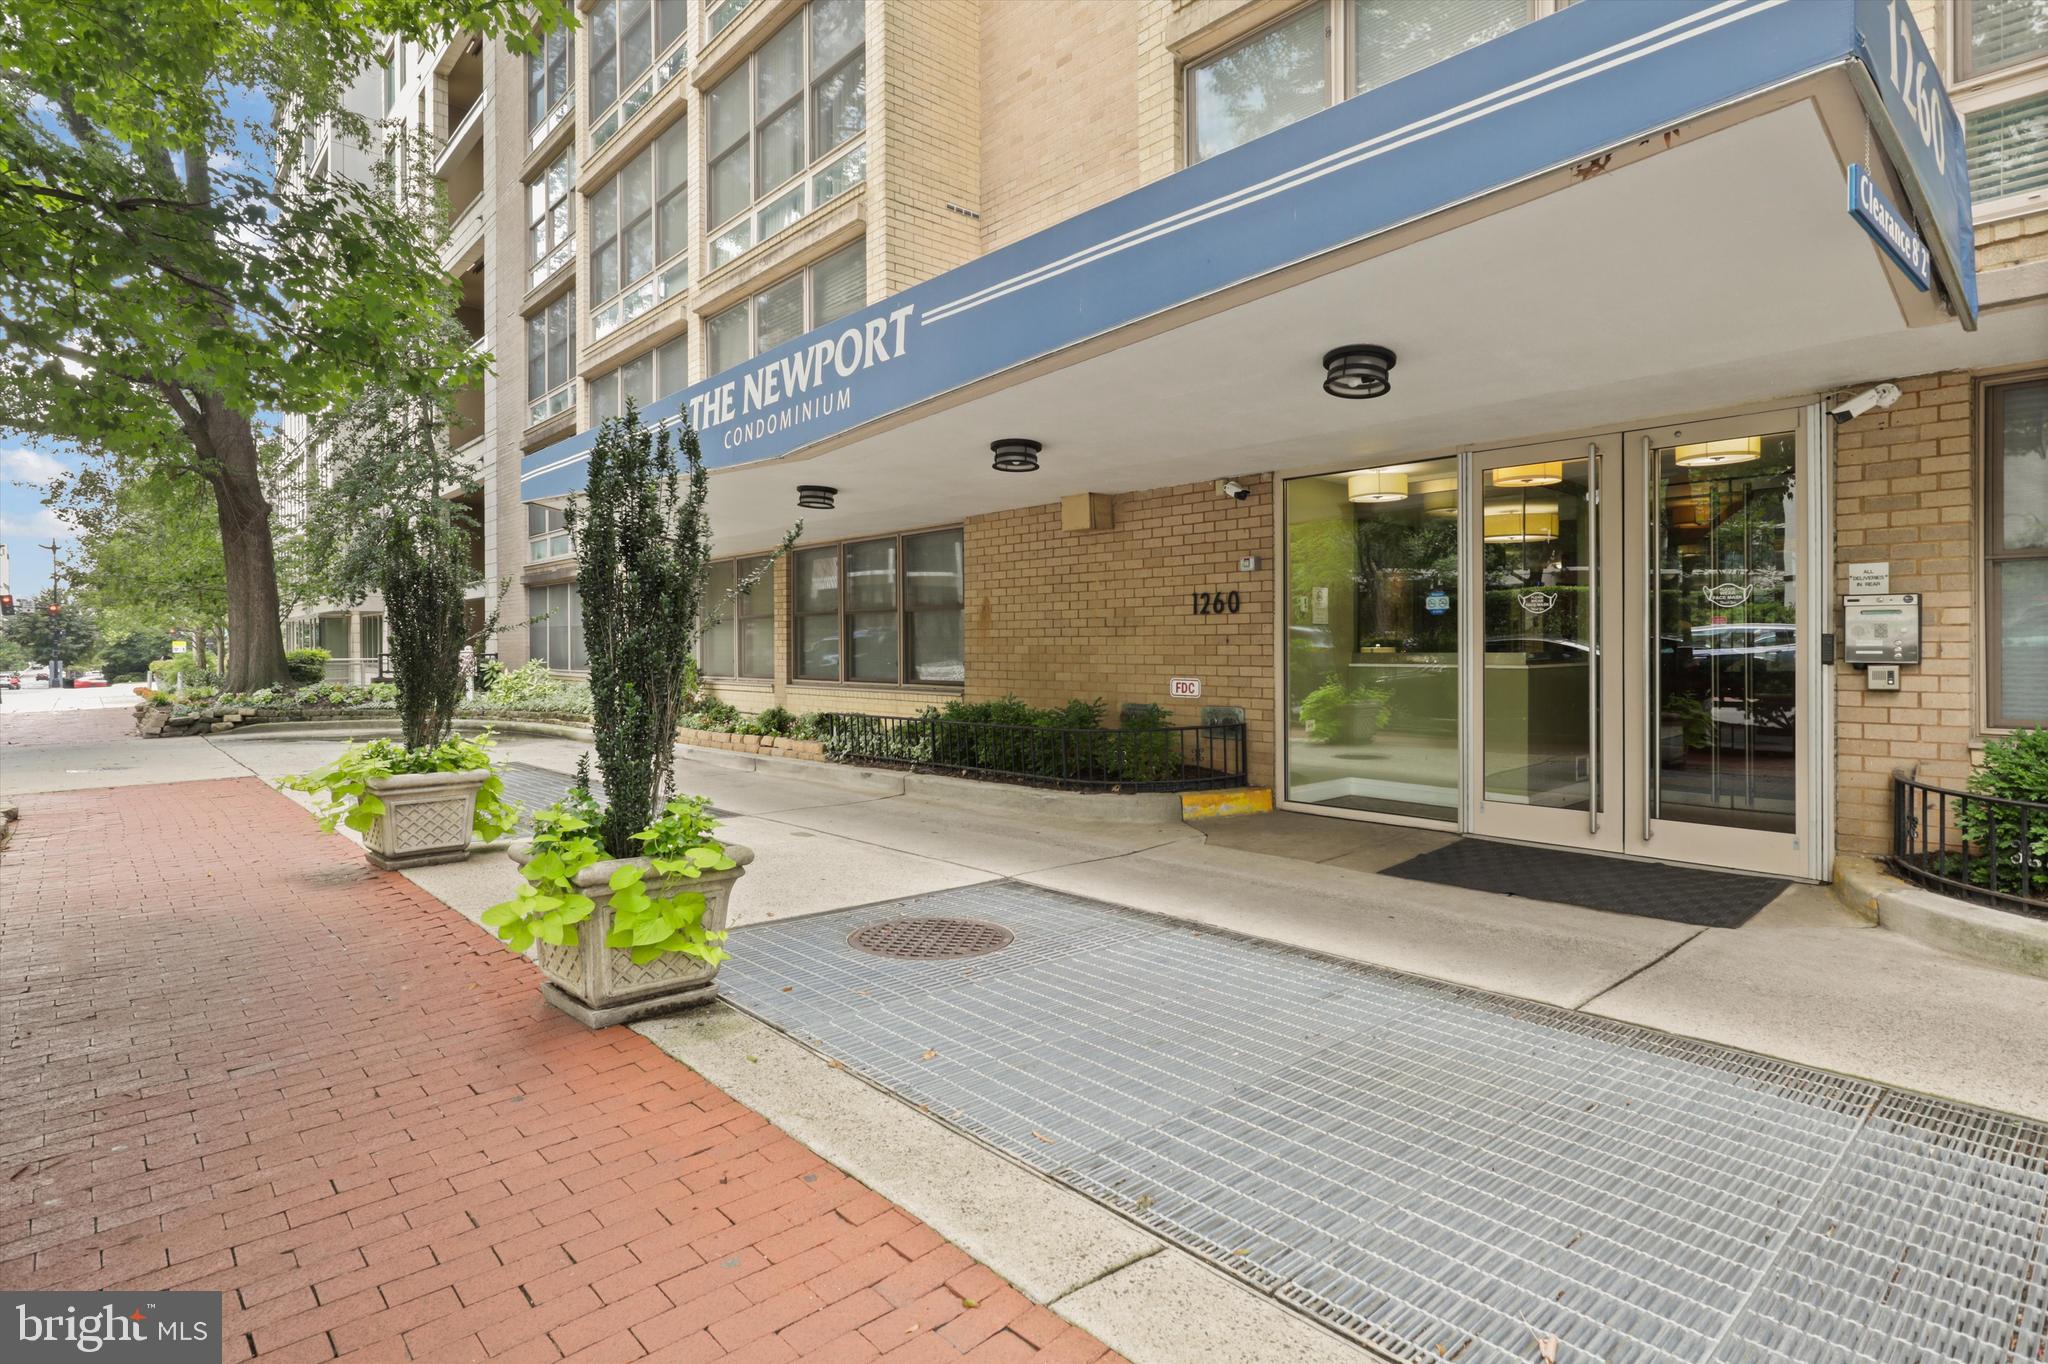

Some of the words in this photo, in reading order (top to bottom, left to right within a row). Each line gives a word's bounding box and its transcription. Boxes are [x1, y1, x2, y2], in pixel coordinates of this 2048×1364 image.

[1887, 0, 1945, 176] 1260
[1860, 175, 1911, 259] Clearance
[689, 381, 736, 433] THE
[742, 303, 915, 416] NEWPORT
[724, 387, 851, 449] CONDOMINIUM
[1192, 590, 1240, 615] 1260
[1175, 682, 1195, 694] FDC
